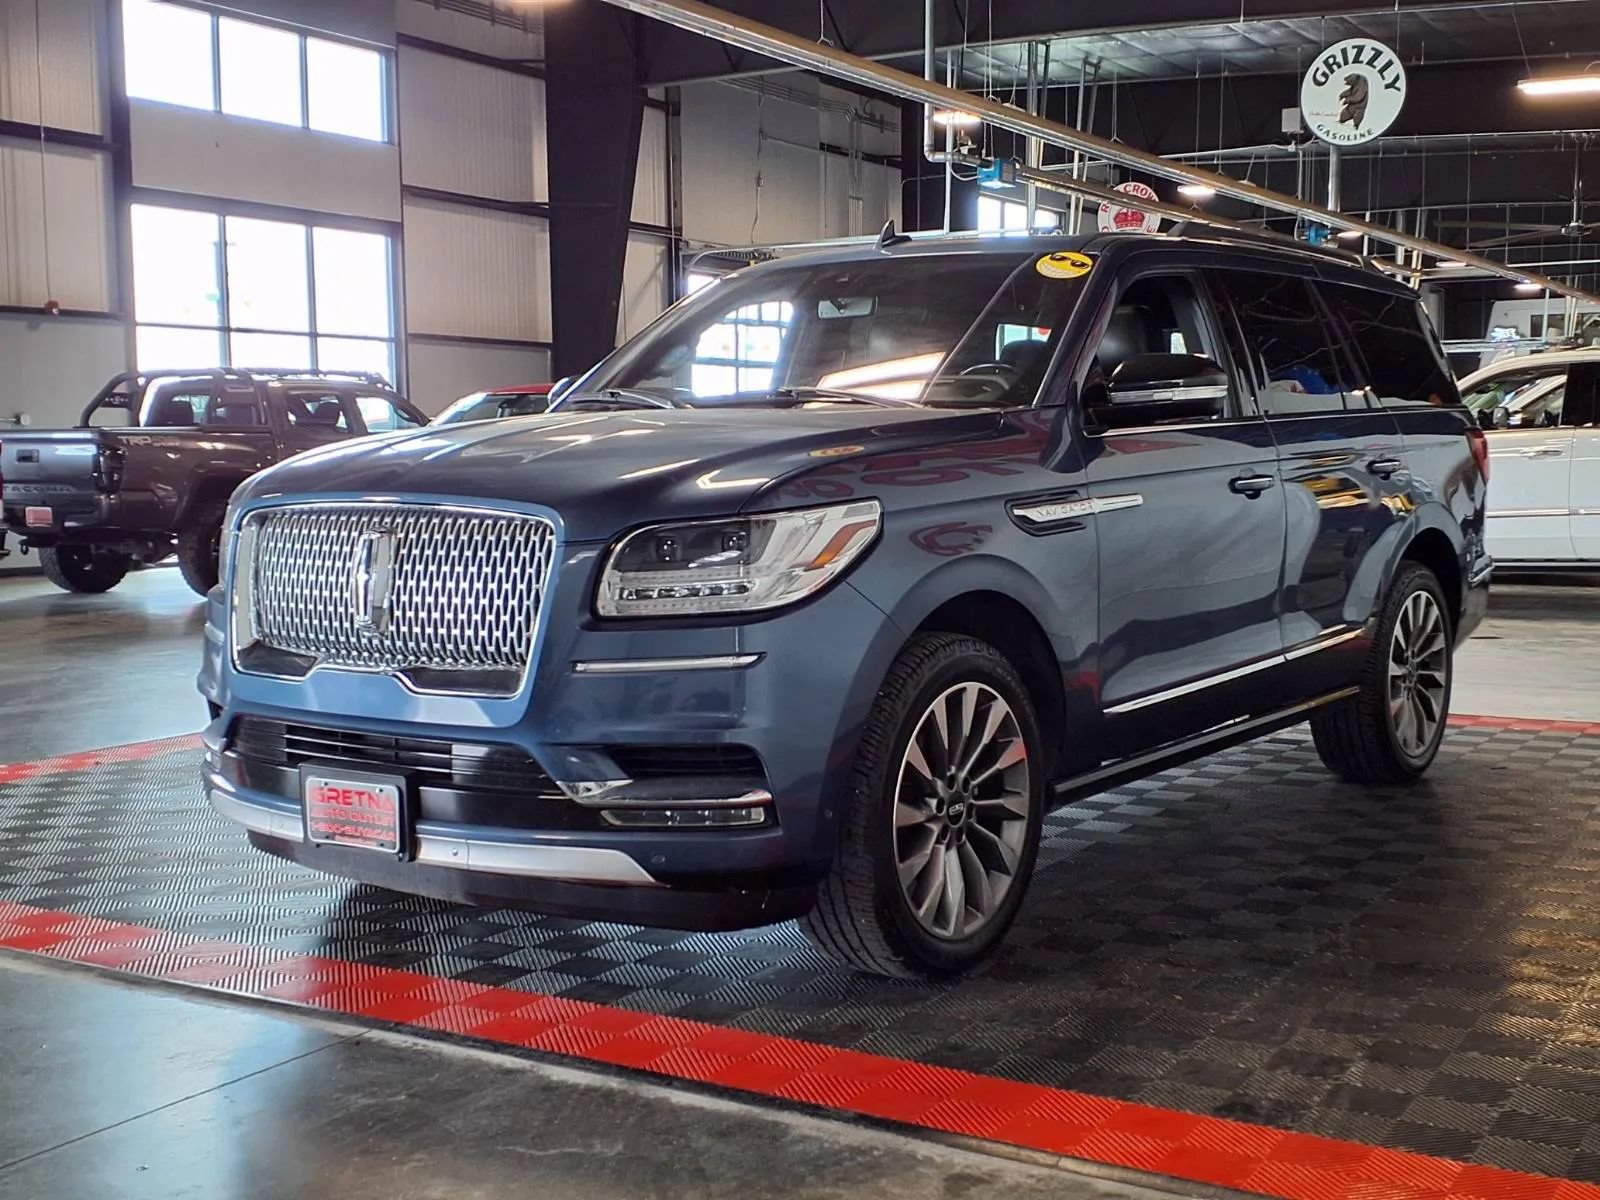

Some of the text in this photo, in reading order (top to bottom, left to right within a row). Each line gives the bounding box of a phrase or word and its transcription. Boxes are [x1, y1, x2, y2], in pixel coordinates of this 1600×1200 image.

[1312, 44, 1401, 92] GRIZZLY
[1316, 123, 1374, 142] GASOLINE
[311, 786, 396, 813] GRETNA
